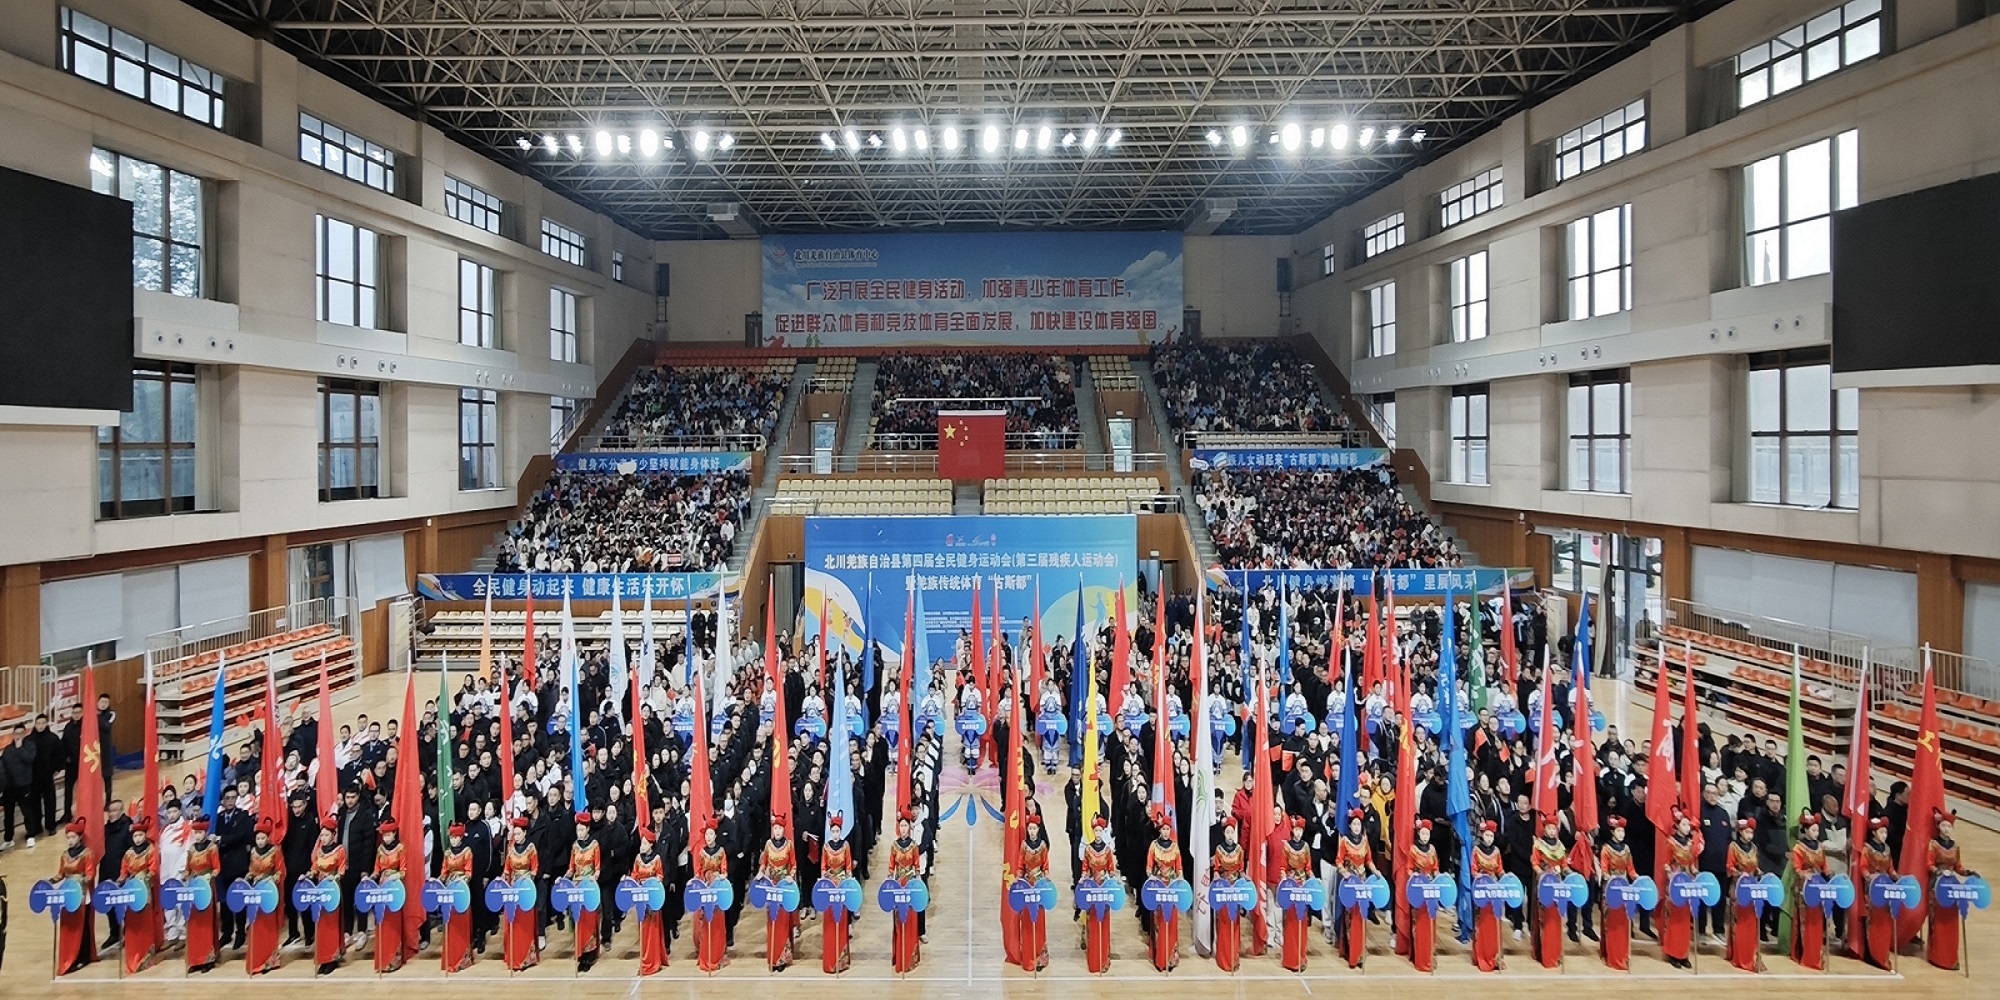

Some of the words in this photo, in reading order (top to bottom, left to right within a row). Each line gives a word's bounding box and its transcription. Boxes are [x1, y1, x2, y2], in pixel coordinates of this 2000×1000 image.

[578, 457, 721, 471] 健身不分少坚持就能身体好
[472, 577, 575, 596] 全民健身动起来
[582, 576, 685, 596] 健康生活乐开怀
